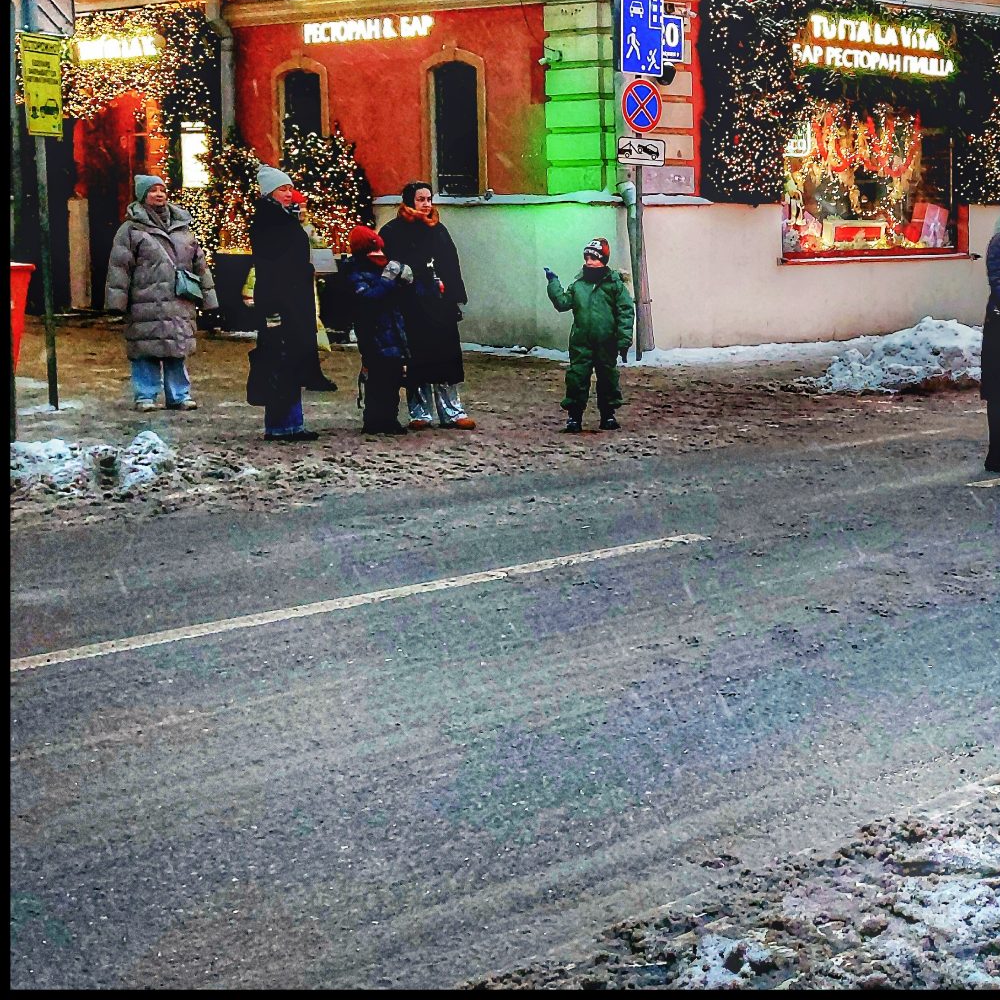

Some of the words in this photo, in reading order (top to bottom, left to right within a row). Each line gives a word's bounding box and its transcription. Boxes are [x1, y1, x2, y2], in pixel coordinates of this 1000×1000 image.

[303, 18, 381, 44] РЕСТОРАН
[382, 17, 399, 39] &
[400, 14, 434, 38] БАР
[874, 23, 899, 46] LA
[791, 42, 823, 64] БАР
[825, 46, 901, 73] РЕСТОРАН
[903, 54, 955, 77] ПИЦЦА
